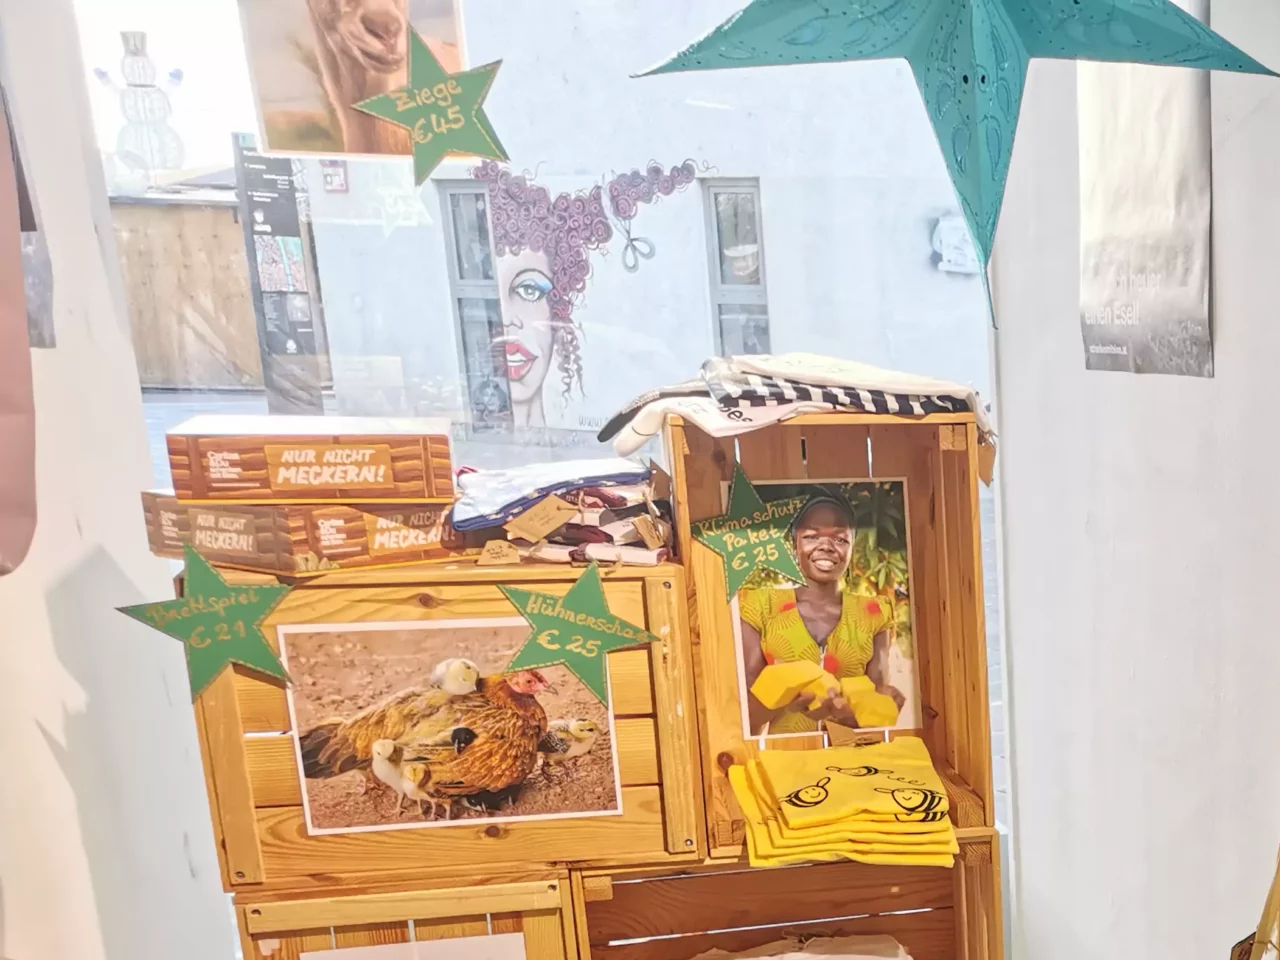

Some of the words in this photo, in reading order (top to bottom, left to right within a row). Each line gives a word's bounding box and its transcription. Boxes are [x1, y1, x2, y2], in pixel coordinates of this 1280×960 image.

[388, 79, 463, 112] Ziege
[281, 449, 318, 464] NUR
[322, 449, 376, 464] NICHT
[276, 465, 387, 485] MECKERN!
[195, 529, 254, 552] MECKERN!
[722, 524, 780, 552] Paket
